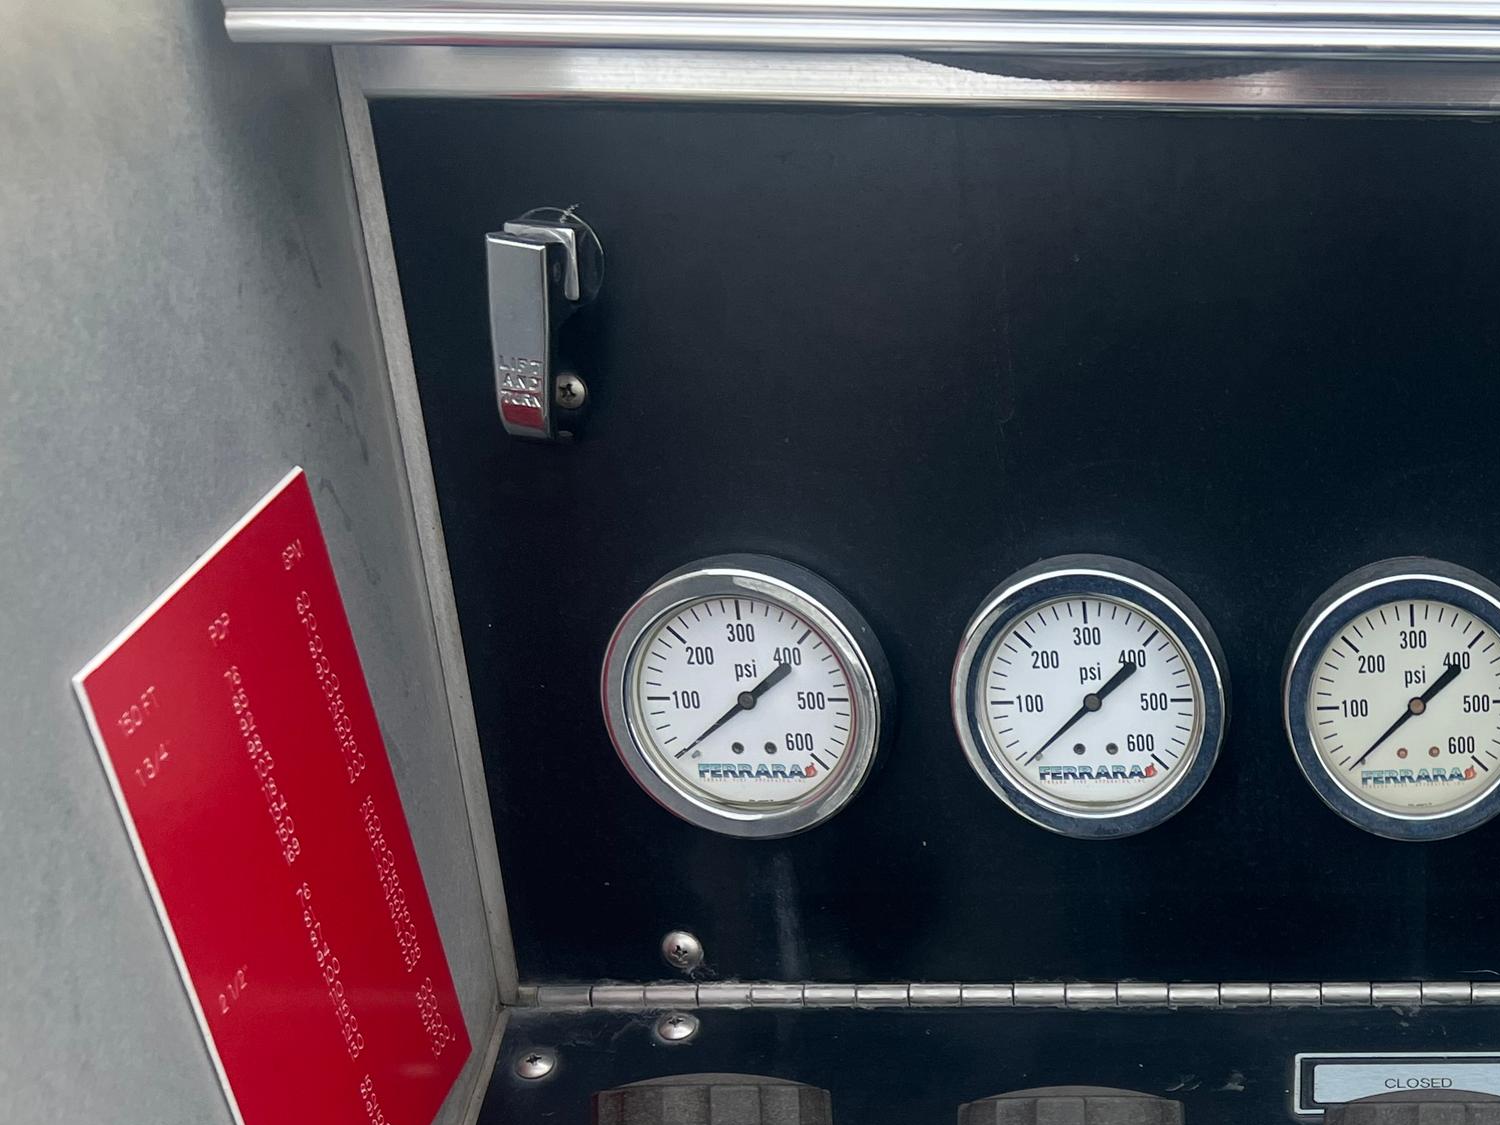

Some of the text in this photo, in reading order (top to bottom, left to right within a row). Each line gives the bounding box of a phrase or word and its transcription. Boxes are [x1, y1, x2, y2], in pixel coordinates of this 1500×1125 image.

[726, 623, 755, 642] 300
[1073, 626, 1101, 645] 300
[1399, 630, 1427, 649] 300
[686, 646, 714, 665] 200
[1031, 650, 1059, 669] 200
[1358, 654, 1385, 673] 200
[735, 660, 757, 682] psi
[1079, 662, 1101, 685] psi
[1404, 665, 1426, 688] psi
[672, 690, 700, 709] 100
[797, 691, 825, 710] 500
[1015, 694, 1044, 713] 100
[1140, 693, 1168, 711] 500
[1341, 699, 1368, 718] 100
[1463, 694, 1490, 713] 500
[785, 733, 814, 752] 600
[1127, 734, 1154, 752] 600
[1448, 736, 1475, 754] 600
[697, 763, 807, 778] FERRARA
[1038, 765, 1147, 781] FERRARA
[1361, 766, 1466, 785] FERRARA
[218, 992, 230, 1015] 2
[1384, 1077, 1453, 1089] CLOSED
